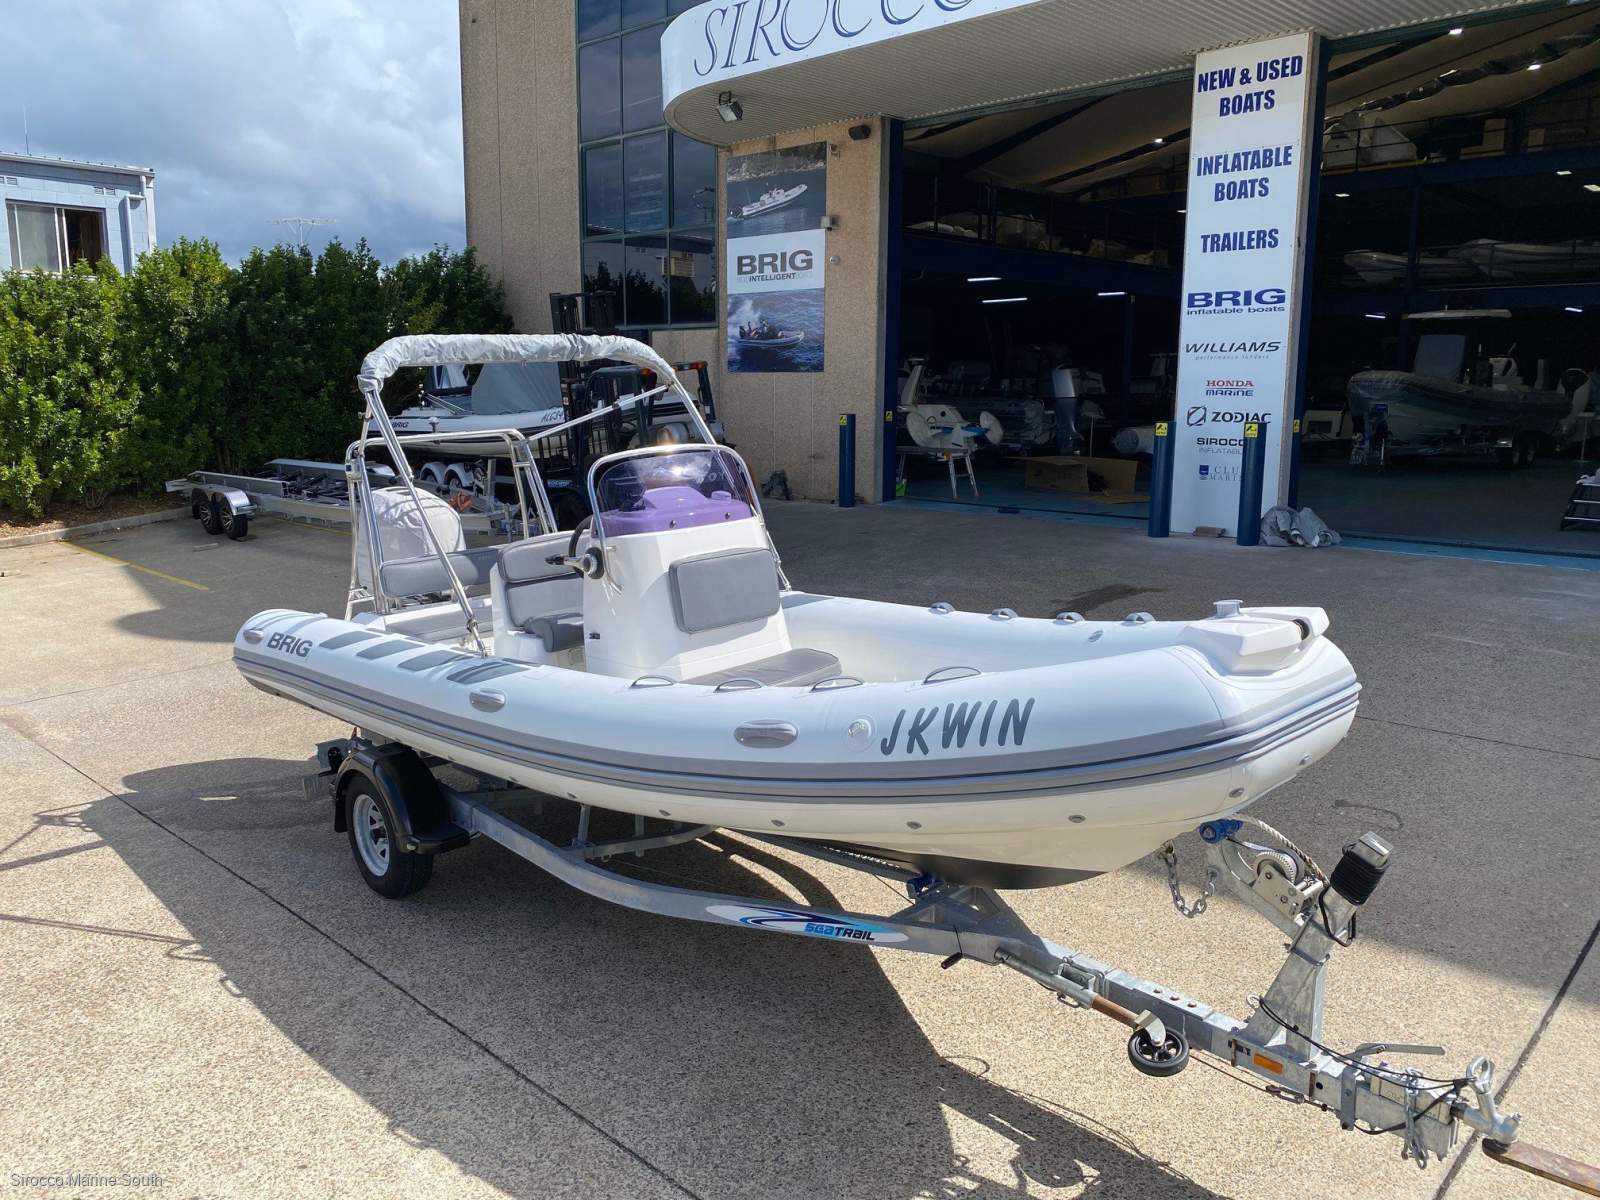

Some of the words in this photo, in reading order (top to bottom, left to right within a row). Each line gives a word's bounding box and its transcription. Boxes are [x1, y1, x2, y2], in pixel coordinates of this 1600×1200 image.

[1198, 67, 1236, 92] NEW
[1239, 68, 1252, 85] &
[1256, 55, 1303, 82] USED
[1219, 89, 1275, 117] BOATS
[1196, 145, 1292, 176] INFLATABLE
[1214, 177, 1270, 202] BOATS
[1200, 228, 1279, 253] TRAILERS
[737, 249, 813, 275] BRIG
[749, 272, 796, 282] INTELLIGENT
[1187, 288, 1286, 308] BRIG
[1187, 307, 1243, 315] inflatable
[1185, 341, 1281, 353] WILLIAMS
[1211, 411, 1271, 424] ZODIAC
[267, 632, 313, 658] BRIG
[880, 697, 1035, 756] JKWIN
